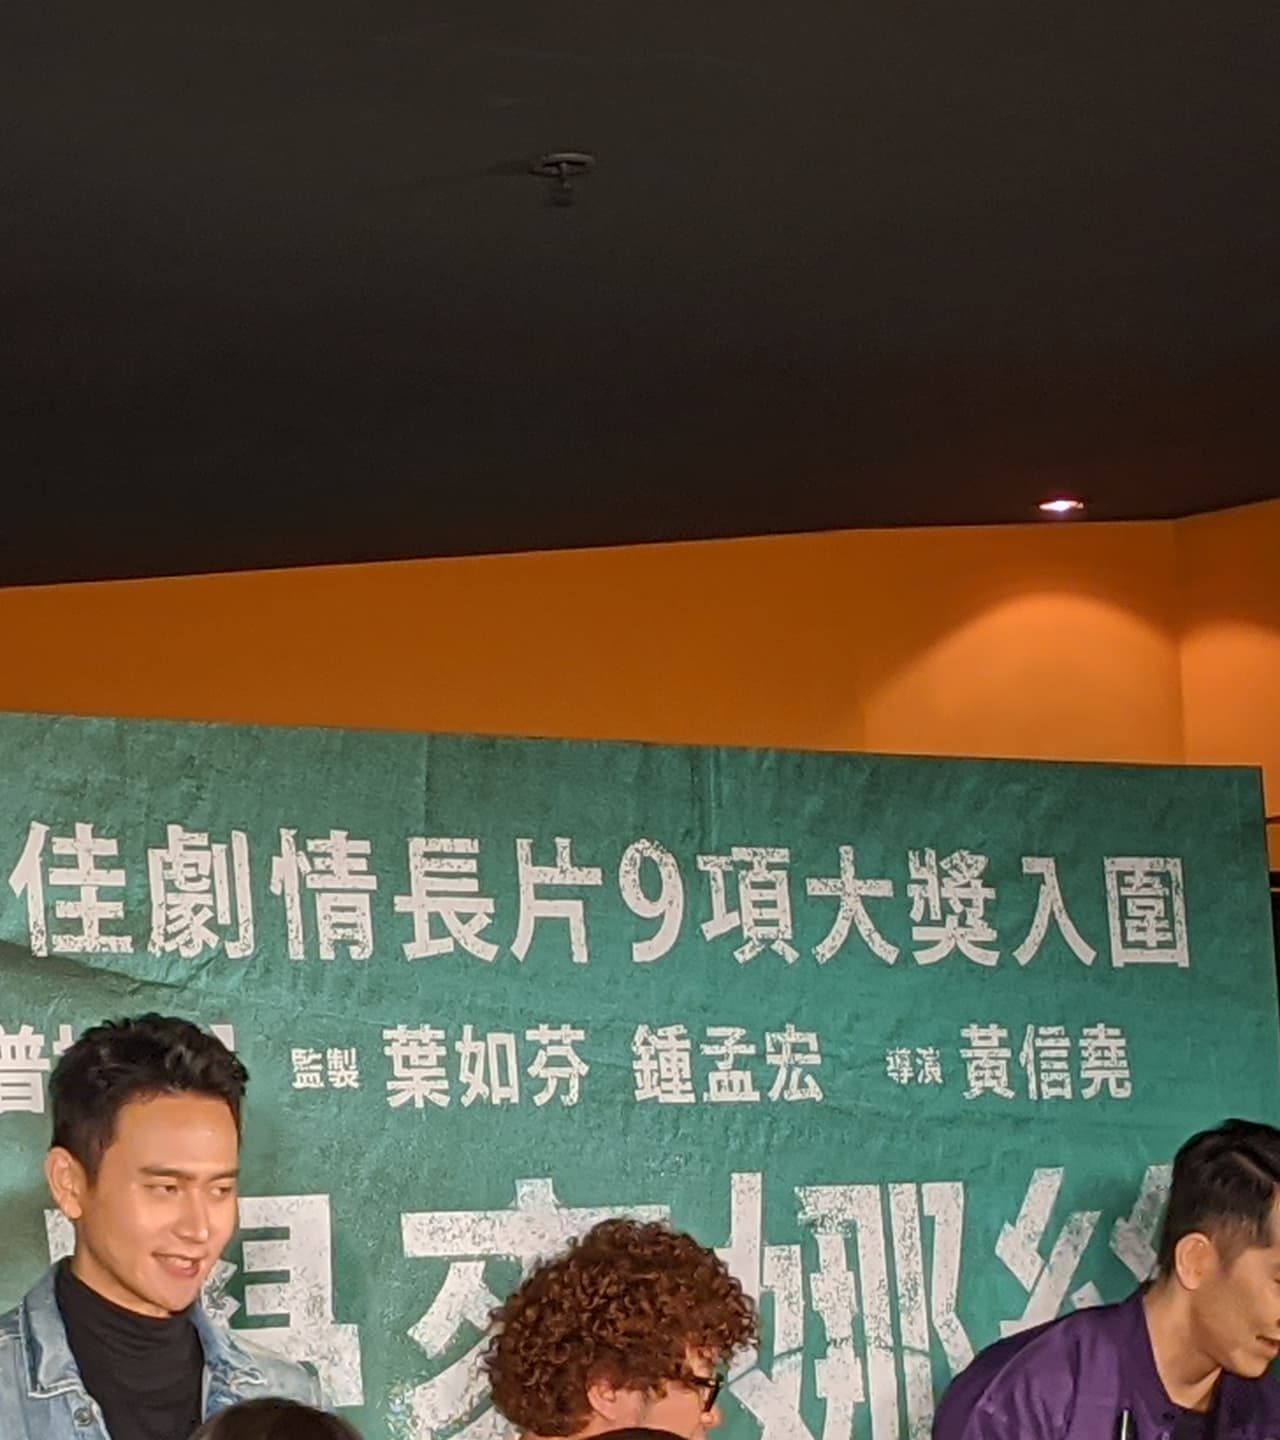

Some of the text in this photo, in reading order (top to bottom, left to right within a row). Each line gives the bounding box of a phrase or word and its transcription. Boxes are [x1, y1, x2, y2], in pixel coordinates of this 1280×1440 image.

[290, 1047, 360, 1089] 監製
[382, 1023, 590, 1109] 葉如芬
[631, 1022, 824, 1104] 鍾孟宏
[885, 1046, 944, 1085] 導演
[960, 1022, 1132, 1101] 黃信堯
